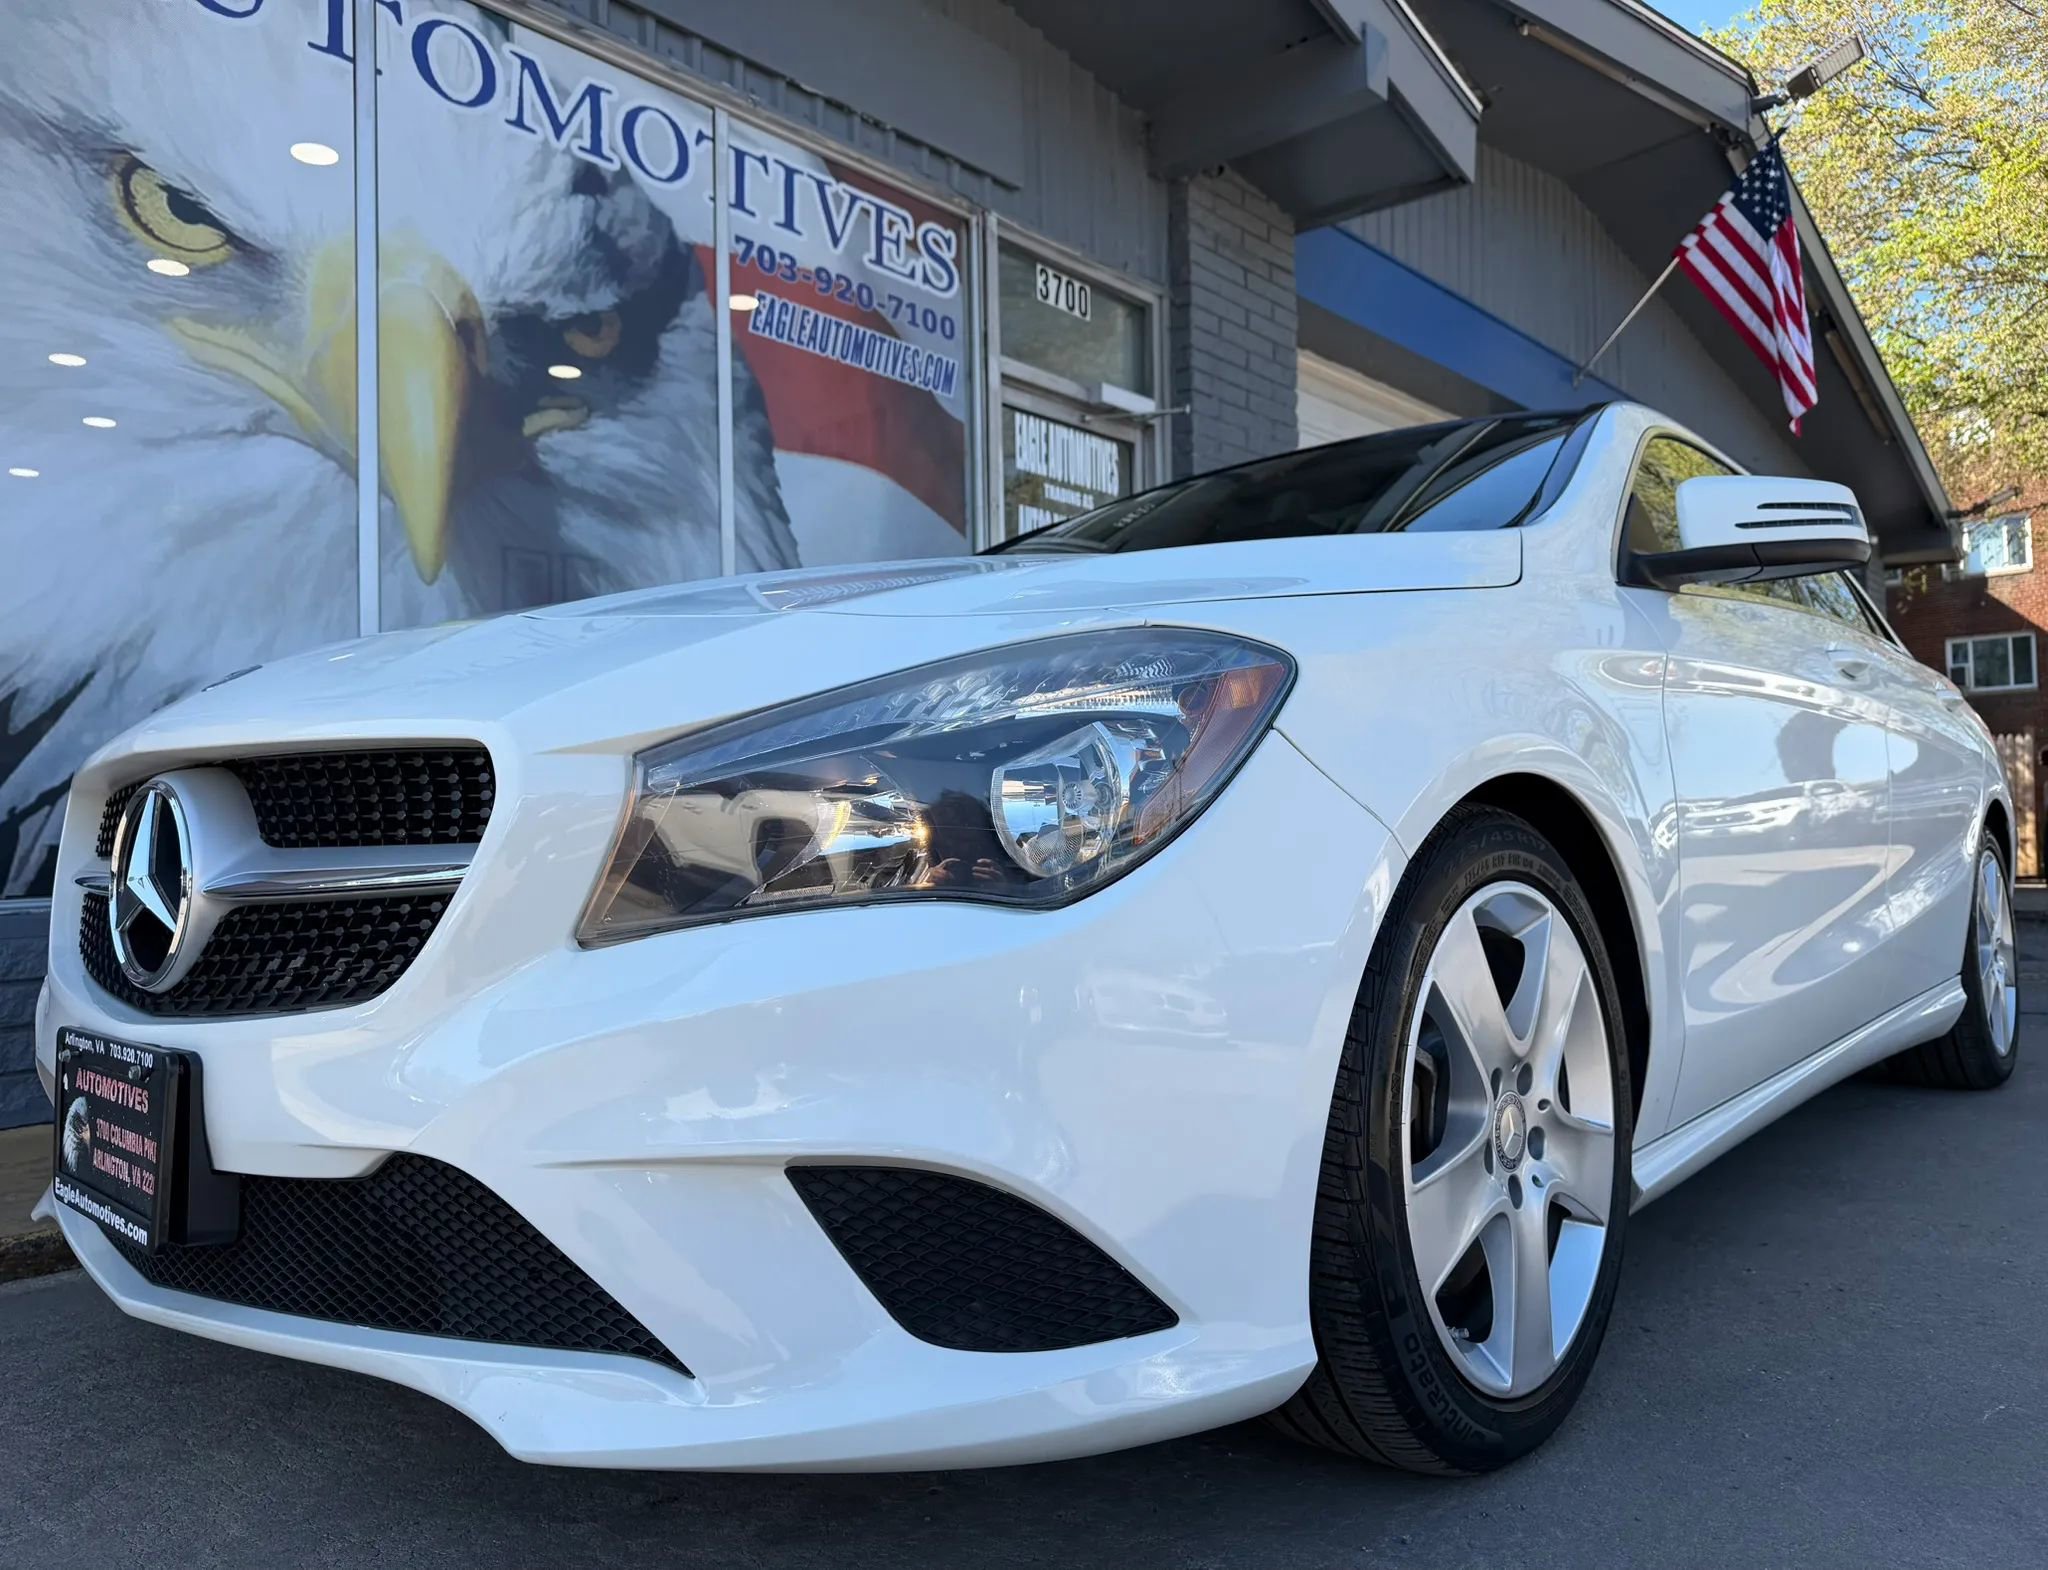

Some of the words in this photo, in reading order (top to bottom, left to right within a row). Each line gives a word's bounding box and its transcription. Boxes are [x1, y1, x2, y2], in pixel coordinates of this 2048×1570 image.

[196, 0, 958, 292] TOMOTIVES
[734, 236, 956, 341] 703-920-7100
[1038, 264, 1089, 318] 3700
[749, 293, 958, 397] EAGLEAUTOMOTIVES.COM
[1014, 411, 1048, 477] EAGLE
[1048, 422, 1120, 498] AUTOMOTIVES
[64, 1031, 94, 1054] Arlington,
[95, 1039, 105, 1055] VA
[109, 1042, 154, 1069] 703.920.7100
[75, 1067, 149, 1114] AUTOMOTIVES
[110, 1124, 143, 1157] COLUMBIA
[131, 1164, 142, 1189] VA
[54, 1176, 148, 1246] EagleAutomotives.com
